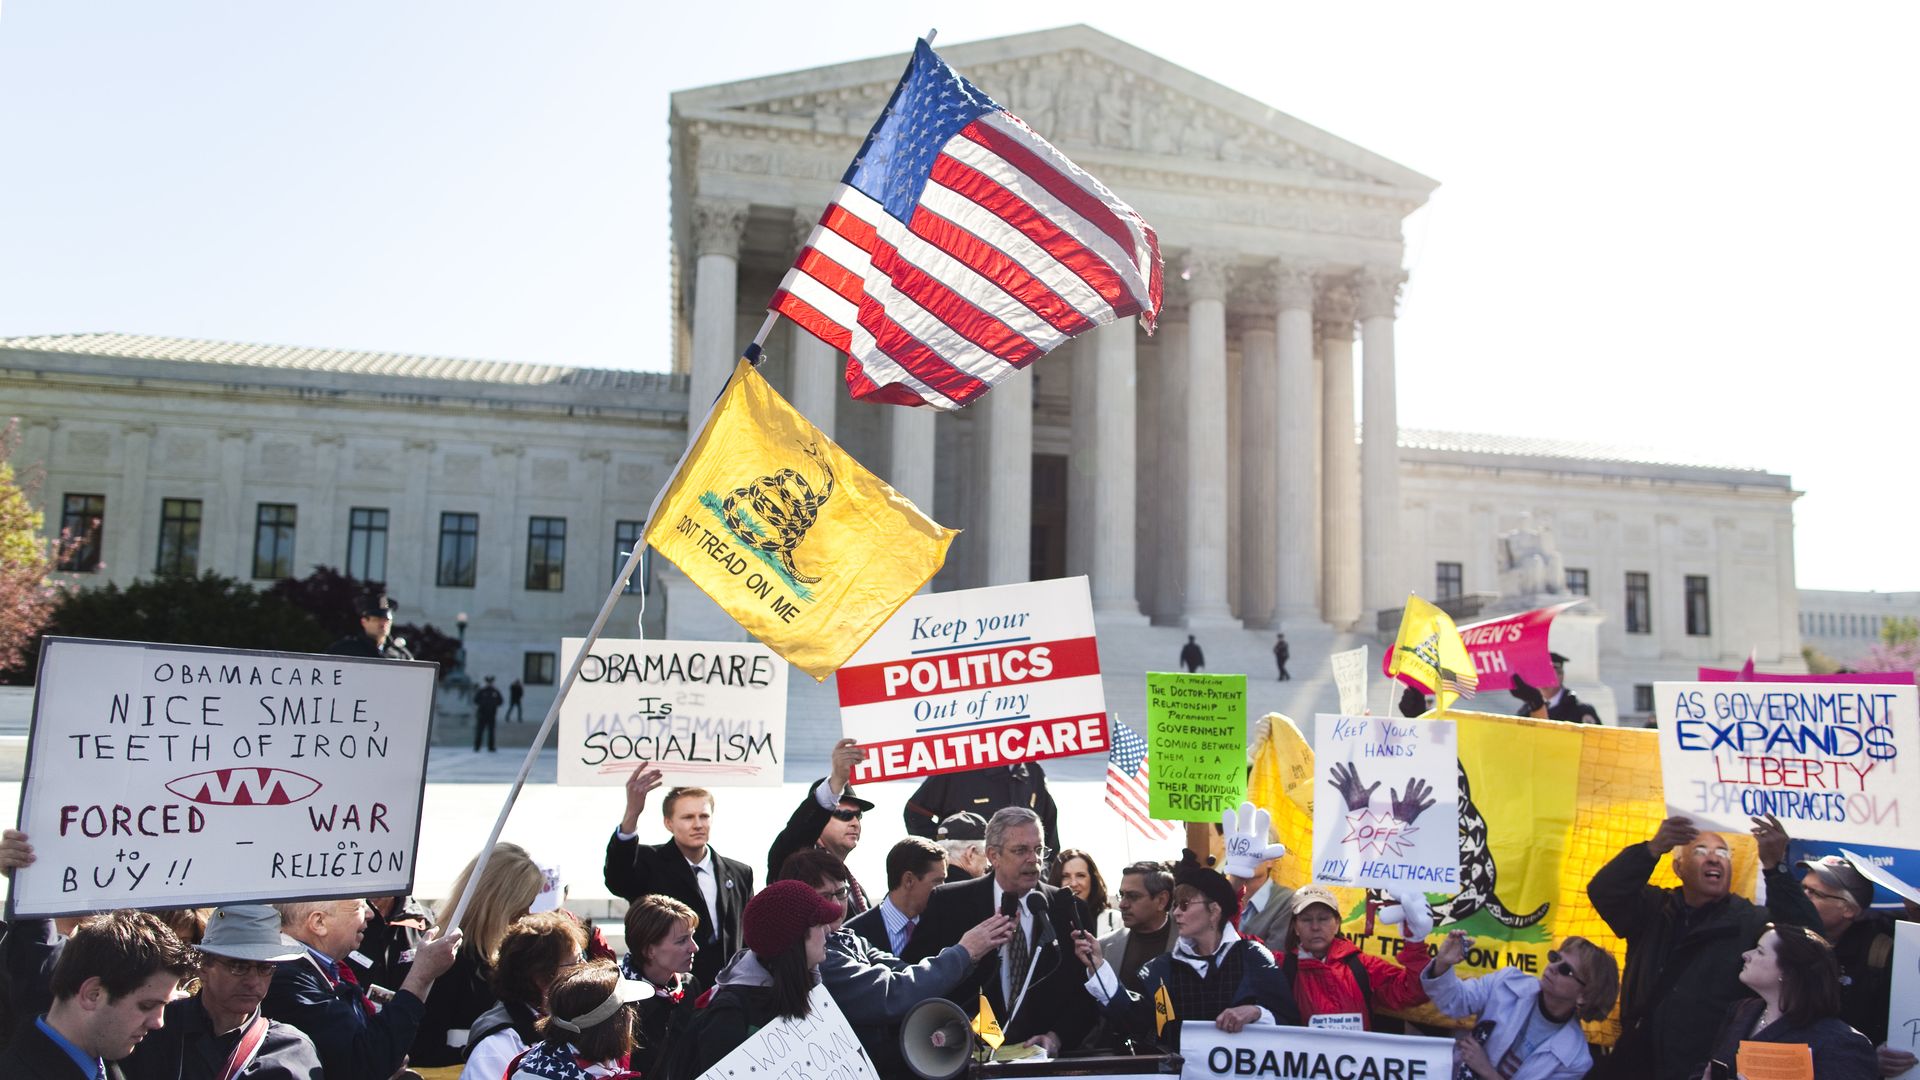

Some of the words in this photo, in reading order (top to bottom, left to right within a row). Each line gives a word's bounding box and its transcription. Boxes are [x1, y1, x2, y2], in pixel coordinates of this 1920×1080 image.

[696, 529, 747, 576] TREAD
[746, 573, 773, 600] ON
[770, 595, 801, 624] ME
[911, 616, 968, 643] Keep
[974, 612, 1030, 640] your
[1463, 623, 1524, 646] MEN'S
[154, 663, 343, 686] OBAMACARE
[579, 653, 769, 687] OBAMACARE
[883, 646, 1054, 697] POLITICS
[914, 699, 957, 721] Out
[967, 690, 991, 719] of
[995, 693, 1029, 714] my
[1153, 698, 1217, 712] RELATIONSHIP
[1170, 685, 1242, 700] DOCTOR-PATIENT
[110, 693, 224, 727] NICE
[258, 696, 380, 732] SMILE,
[1675, 691, 1706, 719] AS
[1715, 692, 1897, 725] GOVERNMENT
[1157, 722, 1235, 736] GOVERNMENT
[1331, 719, 1368, 741] KEEP
[1381, 722, 1419, 745] YOUR
[69, 734, 210, 762] TEETH
[233, 735, 272, 759] OF
[290, 734, 388, 759] IRON
[582, 731, 778, 765] SOCIALISM
[854, 717, 1104, 780] HEALTHCARE
[1156, 737, 1197, 749] COMING
[1201, 741, 1241, 750] BETWEEN
[1365, 743, 1417, 757] HANDS
[1156, 751, 1184, 762] THEM
[1194, 755, 1205, 763] IS
[1214, 755, 1221, 764] A
[1226, 766, 1239, 783] of
[1716, 755, 1875, 791] LIBERTY
[1157, 781, 1188, 792] THEIR
[1195, 783, 1241, 795] INDIVIDUAL
[1168, 793, 1237, 812] RIGHTS
[1741, 789, 1846, 823] CONTRACTS
[60, 804, 205, 839] FORCED
[309, 803, 390, 833] WAR
[337, 840, 358, 850] on
[1359, 825, 1399, 841] OFF
[115, 848, 140, 862] to
[272, 850, 404, 879] RELIGION
[1360, 861, 1456, 883] HEALTHCARE
[1466, 948, 1499, 969] ON
[1507, 952, 1537, 973] ME
[1208, 1046, 1427, 1080] OBAMACARE
